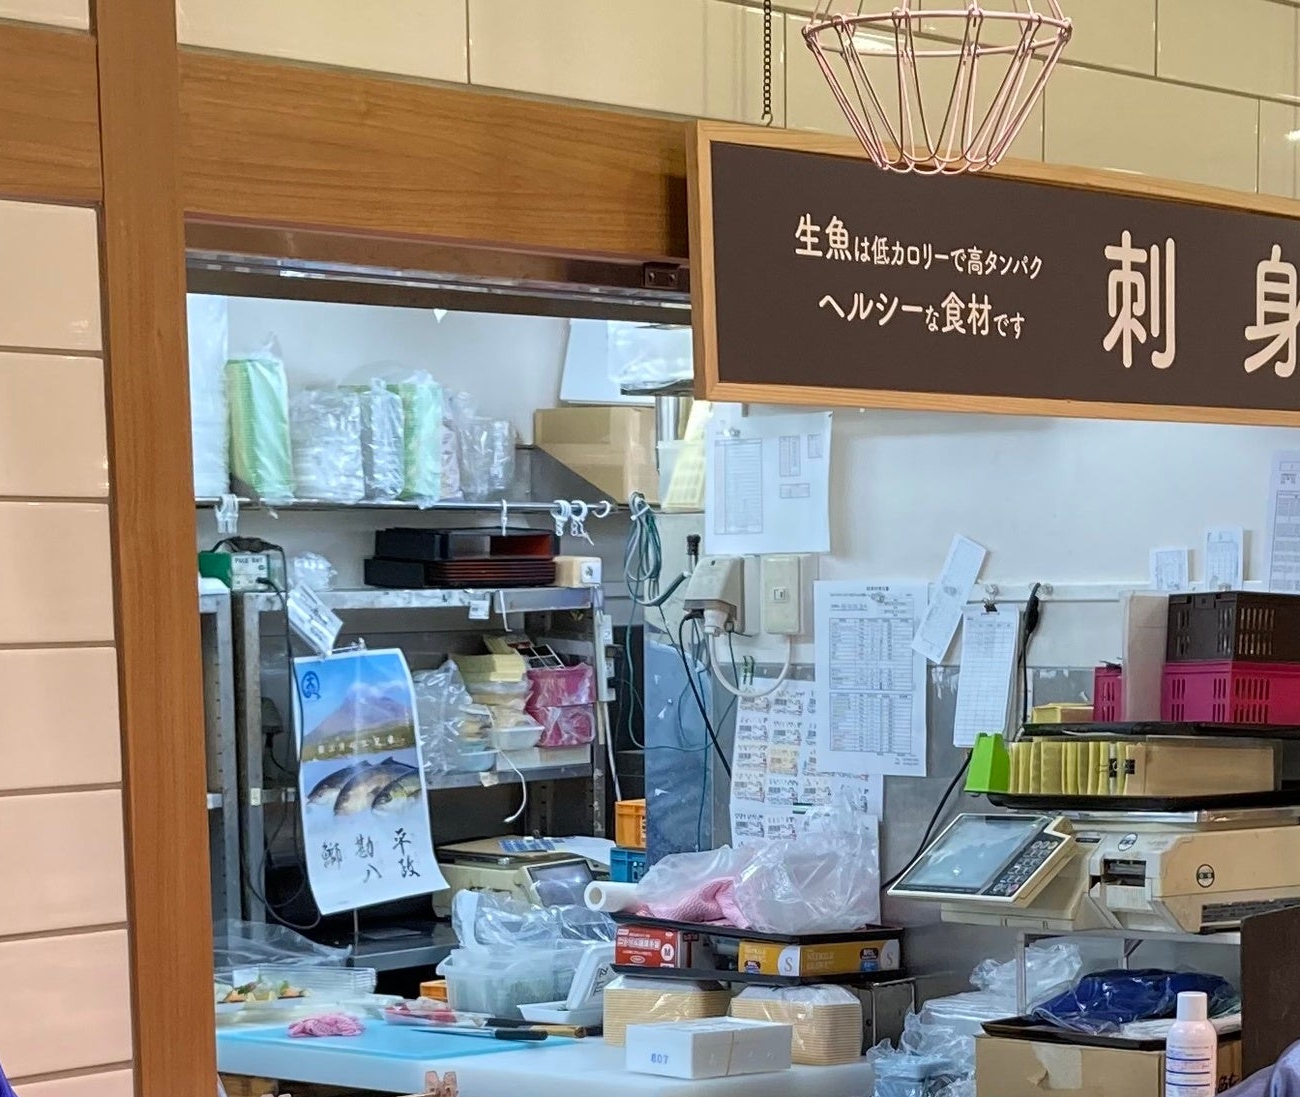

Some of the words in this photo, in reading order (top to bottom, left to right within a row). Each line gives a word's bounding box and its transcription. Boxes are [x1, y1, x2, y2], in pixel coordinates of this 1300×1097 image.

[795, 213, 1042, 279] 生魚は低カロリーで高タンパク
[819, 291, 1025, 339] ヘルシーな食材です
[784, 957, 793, 971] S
[886, 951, 893, 967] S
